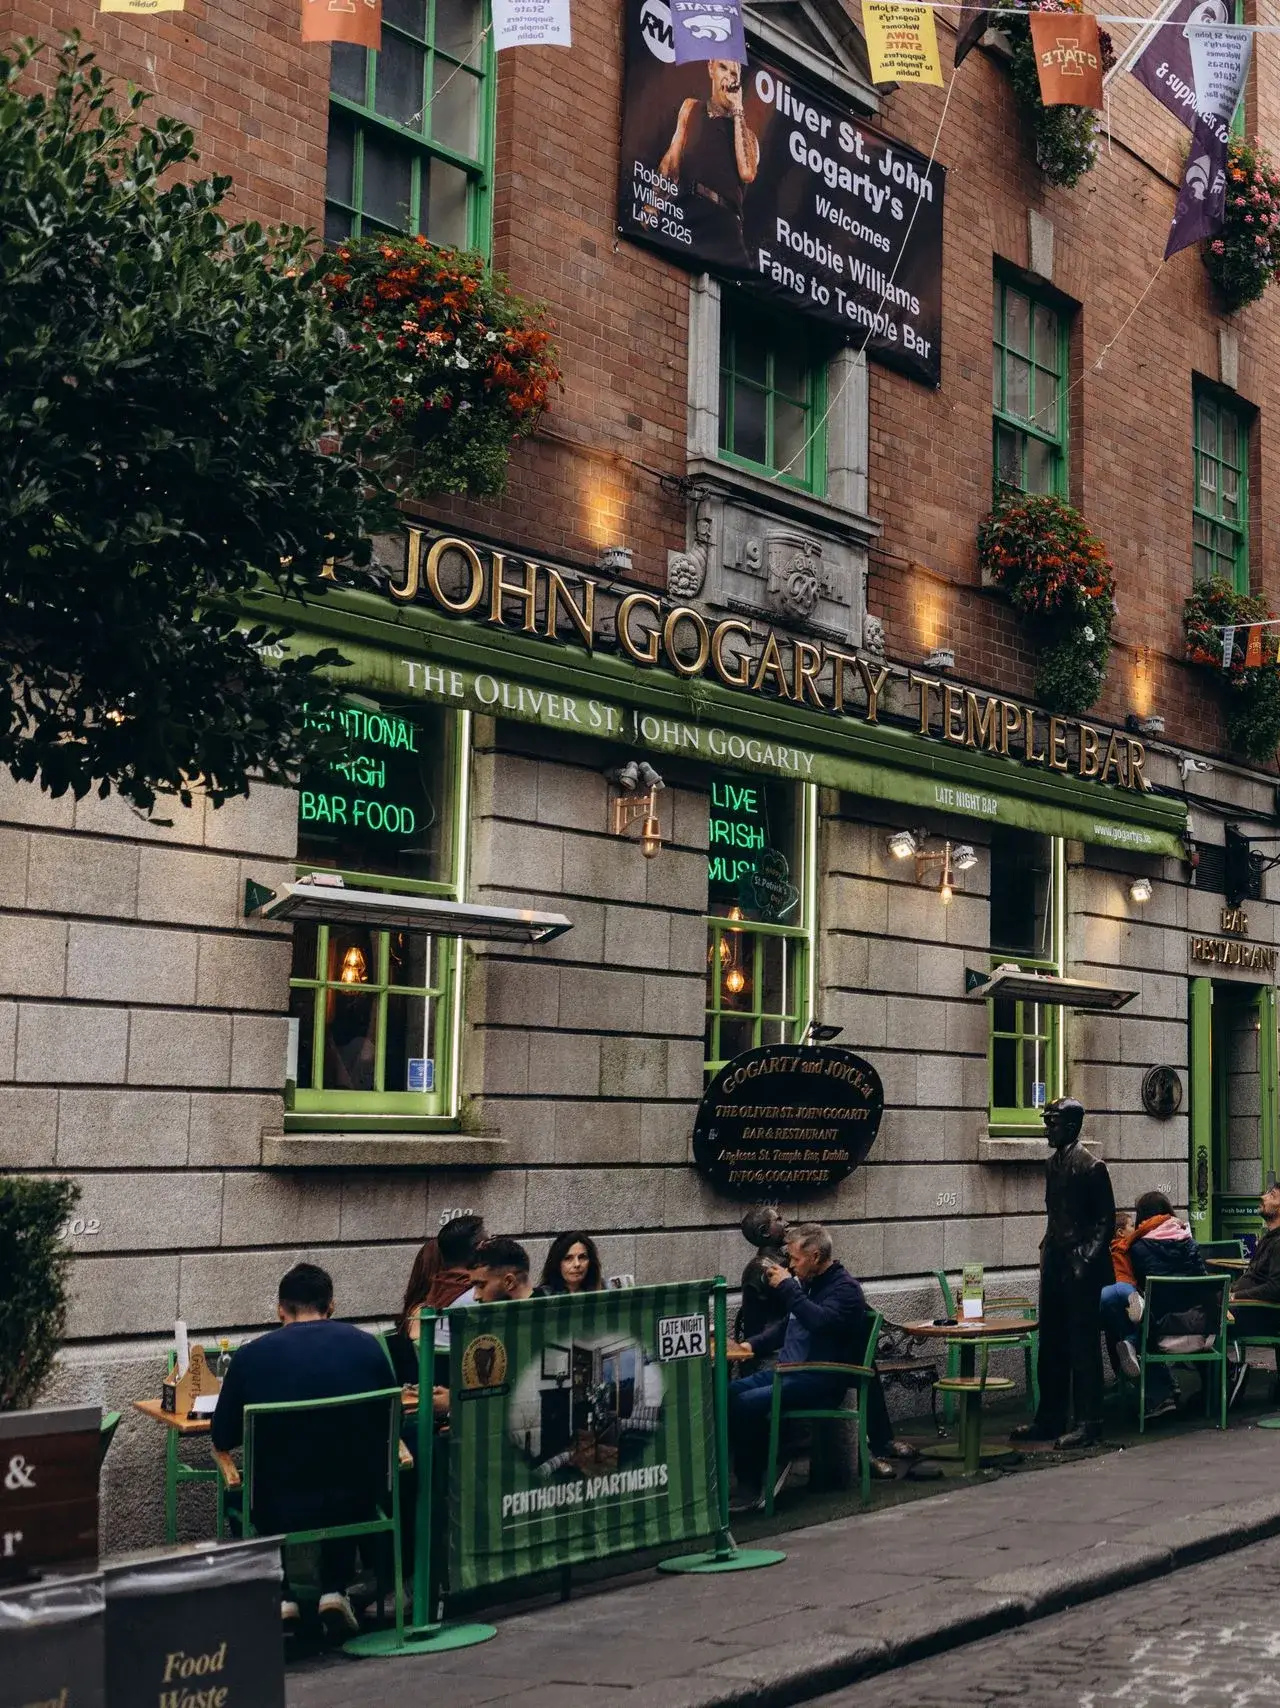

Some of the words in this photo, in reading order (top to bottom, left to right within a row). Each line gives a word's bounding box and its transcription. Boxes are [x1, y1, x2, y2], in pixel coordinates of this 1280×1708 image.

[1156, 62, 1171, 78] &
[1215, 124, 1229, 143] to
[755, 70, 832, 138] Oliver
[838, 121, 870, 164] St.
[879, 149, 934, 202] John
[634, 160, 679, 196] Robbie
[789, 130, 904, 221] Gogarty's
[633, 182, 684, 220] Williams
[632, 203, 658, 228] Live
[661, 218, 692, 245] 2025
[815, 195, 891, 253] Welcomes
[776, 216, 844, 274] Robbie
[849, 255, 920, 316] Williams
[758, 249, 805, 294] Fans
[810, 277, 830, 305] to
[835, 287, 897, 341] Temple
[903, 324, 931, 359] Bar
[389, 526, 597, 652] JOHN
[617, 593, 892, 724] GOGARTY
[910, 672, 1068, 772] TEMPLE
[1079, 724, 1150, 792] BAR
[401, 659, 466, 699] THE
[474, 674, 582, 724] OLIVER
[588, 699, 625, 733] ST.
[633, 710, 700, 750] JOHN
[708, 728, 815, 774] GOGARTY
[302, 792, 347, 825] BAR
[353, 800, 415, 834] FOOD
[712, 782, 758, 814] LIVE
[934, 786, 954, 806] LATE
[956, 790, 980, 812] NIGHT
[980, 795, 998, 815] BAR
[708, 818, 764, 849] IRISH
[1093, 824, 1151, 845] www.gogartys.ie
[1221, 908, 1249, 934] BAR
[1191, 936, 1279, 971] RESTAURANT
[722, 1056, 801, 1094] GOGARTY
[801, 1059, 822, 1074] and
[825, 1061, 866, 1089] JOYCE
[715, 1105, 738, 1118] THE
[739, 1106, 780, 1119] OLIVER
[795, 1107, 823, 1119] JOHN
[823, 1107, 871, 1121] GOGARTY
[742, 1127, 765, 1140] BAR
[765, 1128, 776, 1140] &
[776, 1128, 839, 1141] RESTAURANT
[772, 1149, 802, 1164] Temple
[821, 1150, 849, 1161] Dublin
[937, 1192, 957, 1206] 505
[55, 1219, 100, 1240] 502
[660, 1320, 680, 1336] LATE
[680, 1317, 703, 1334] NIGHT
[662, 1333, 702, 1358] BAR
[4, 1454, 36, 1490] &
[502, 1480, 584, 1519] PENTHOUSE
[586, 1463, 669, 1500] APARTMENTS
[162, 1641, 228, 1684] Food
[159, 1686, 229, 1708] Waste
